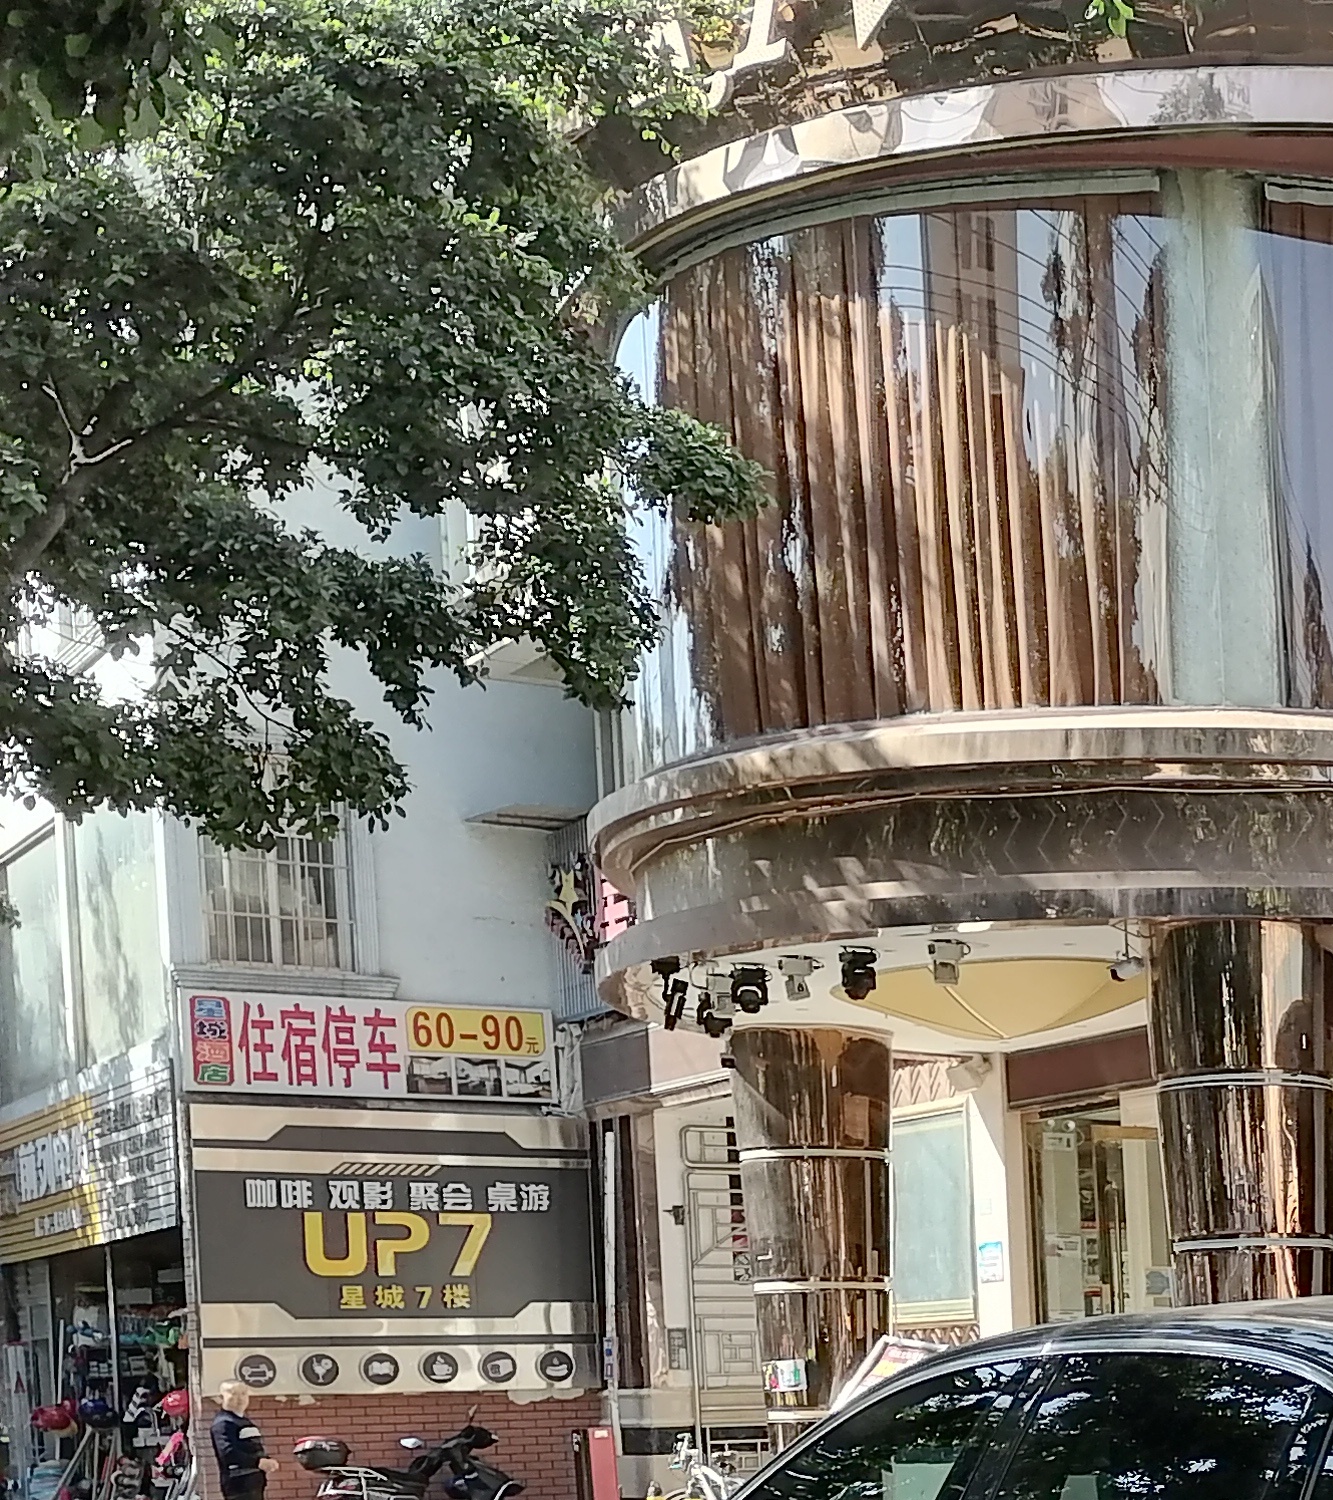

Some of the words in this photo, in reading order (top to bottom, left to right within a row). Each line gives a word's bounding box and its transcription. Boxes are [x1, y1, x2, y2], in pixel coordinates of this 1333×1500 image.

[238, 1000, 401, 1090] 住宿停车
[413, 1011, 541, 1054] 60-90元
[245, 1179, 312, 1209] 咖啡
[329, 1180, 393, 1210] 观影
[409, 1182, 473, 1212] 聚会
[487, 1182, 550, 1212] 桌游
[303, 1211, 493, 1277] UP7
[340, 1284, 471, 1309] 星城7楼
